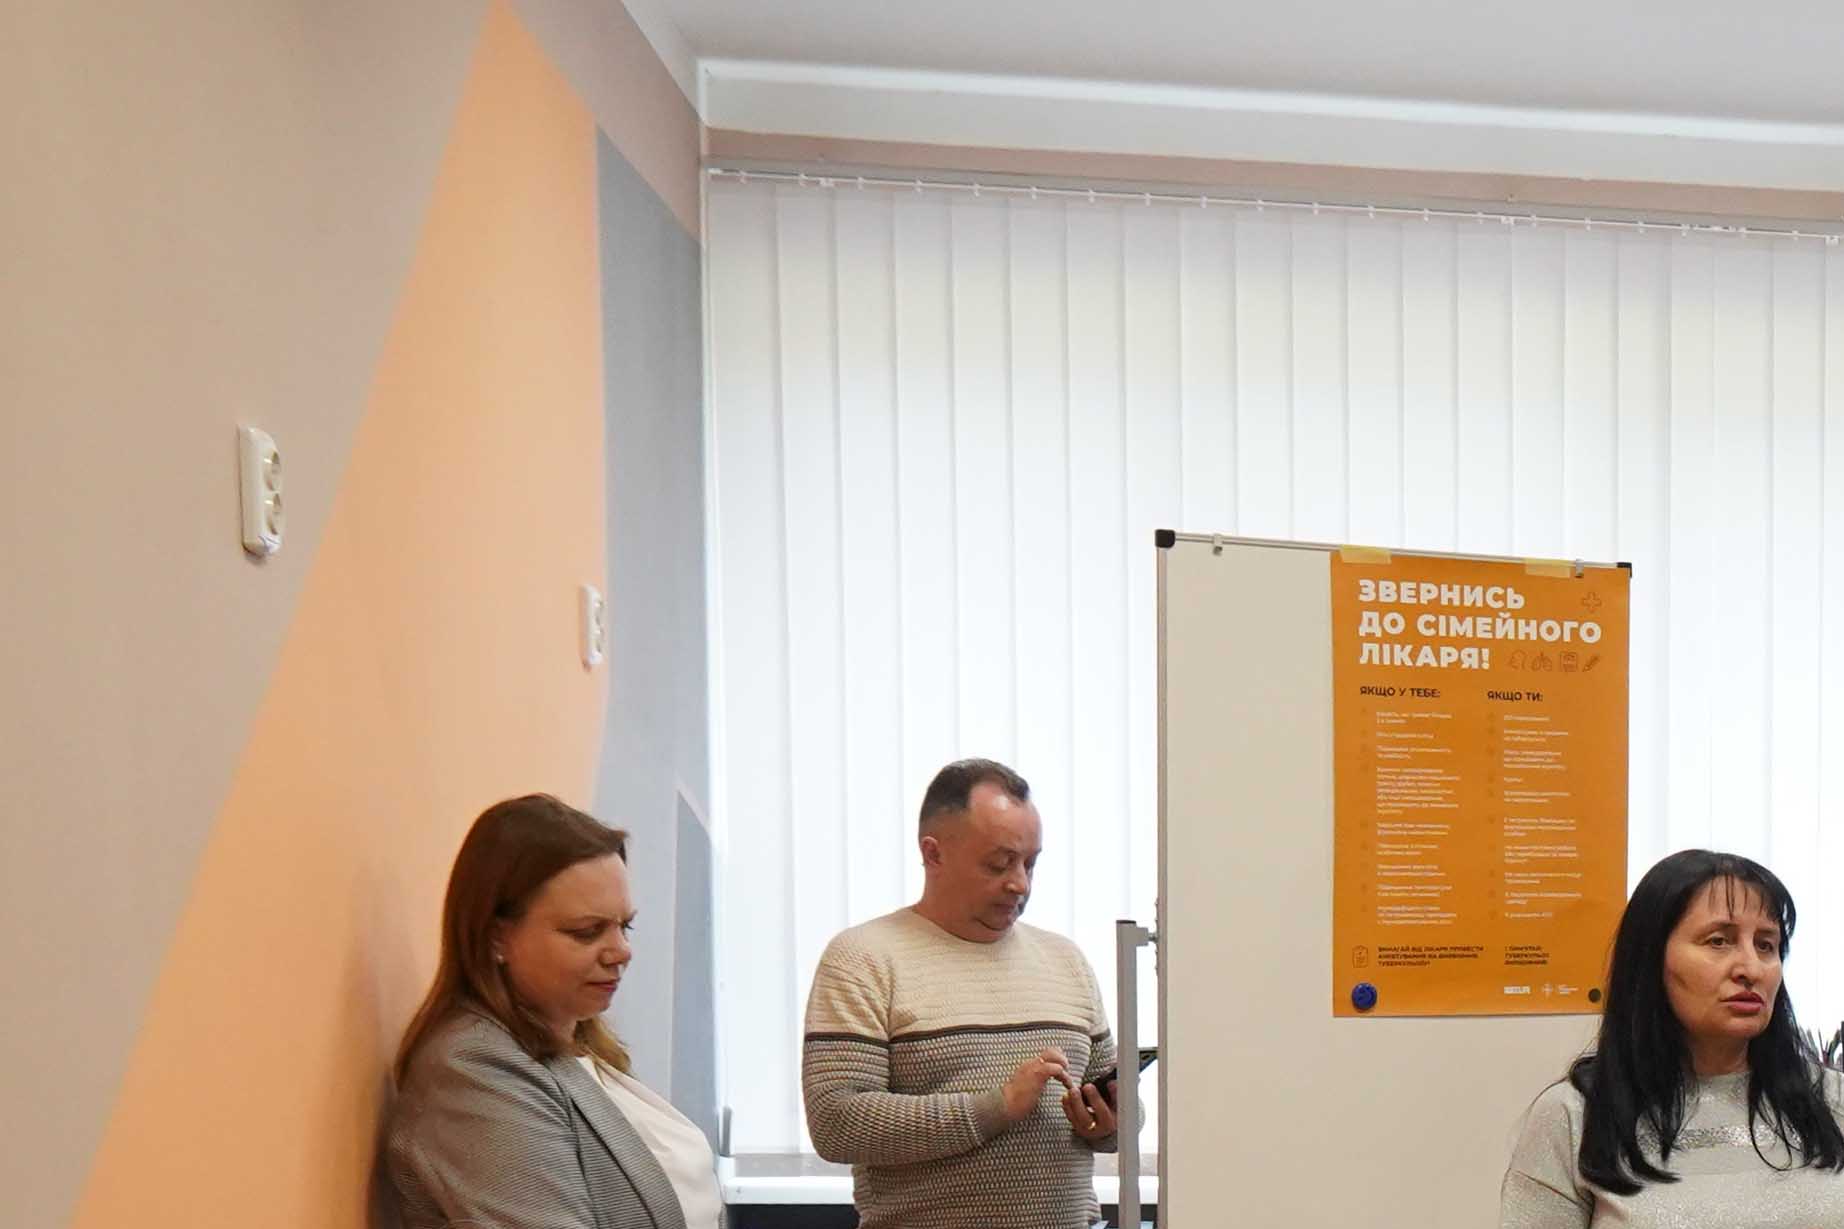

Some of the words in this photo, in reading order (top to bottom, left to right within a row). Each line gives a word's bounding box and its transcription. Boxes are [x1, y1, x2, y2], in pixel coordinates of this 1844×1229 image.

[1359, 579, 1525, 610] ЗВЕРНИСЬ
[1359, 611, 1405, 637] ДО
[1417, 612, 1601, 644] СІМЕЙНОГО
[1359, 642, 1490, 670] ЛІКАРЯ!
[1360, 686, 1396, 697] ЯКЩО
[1399, 687, 1407, 697] У
[1410, 688, 1441, 698] ТЕБЕ:
[1487, 691, 1522, 701] ЯКЩО
[1526, 692, 1543, 702] ТИ:
